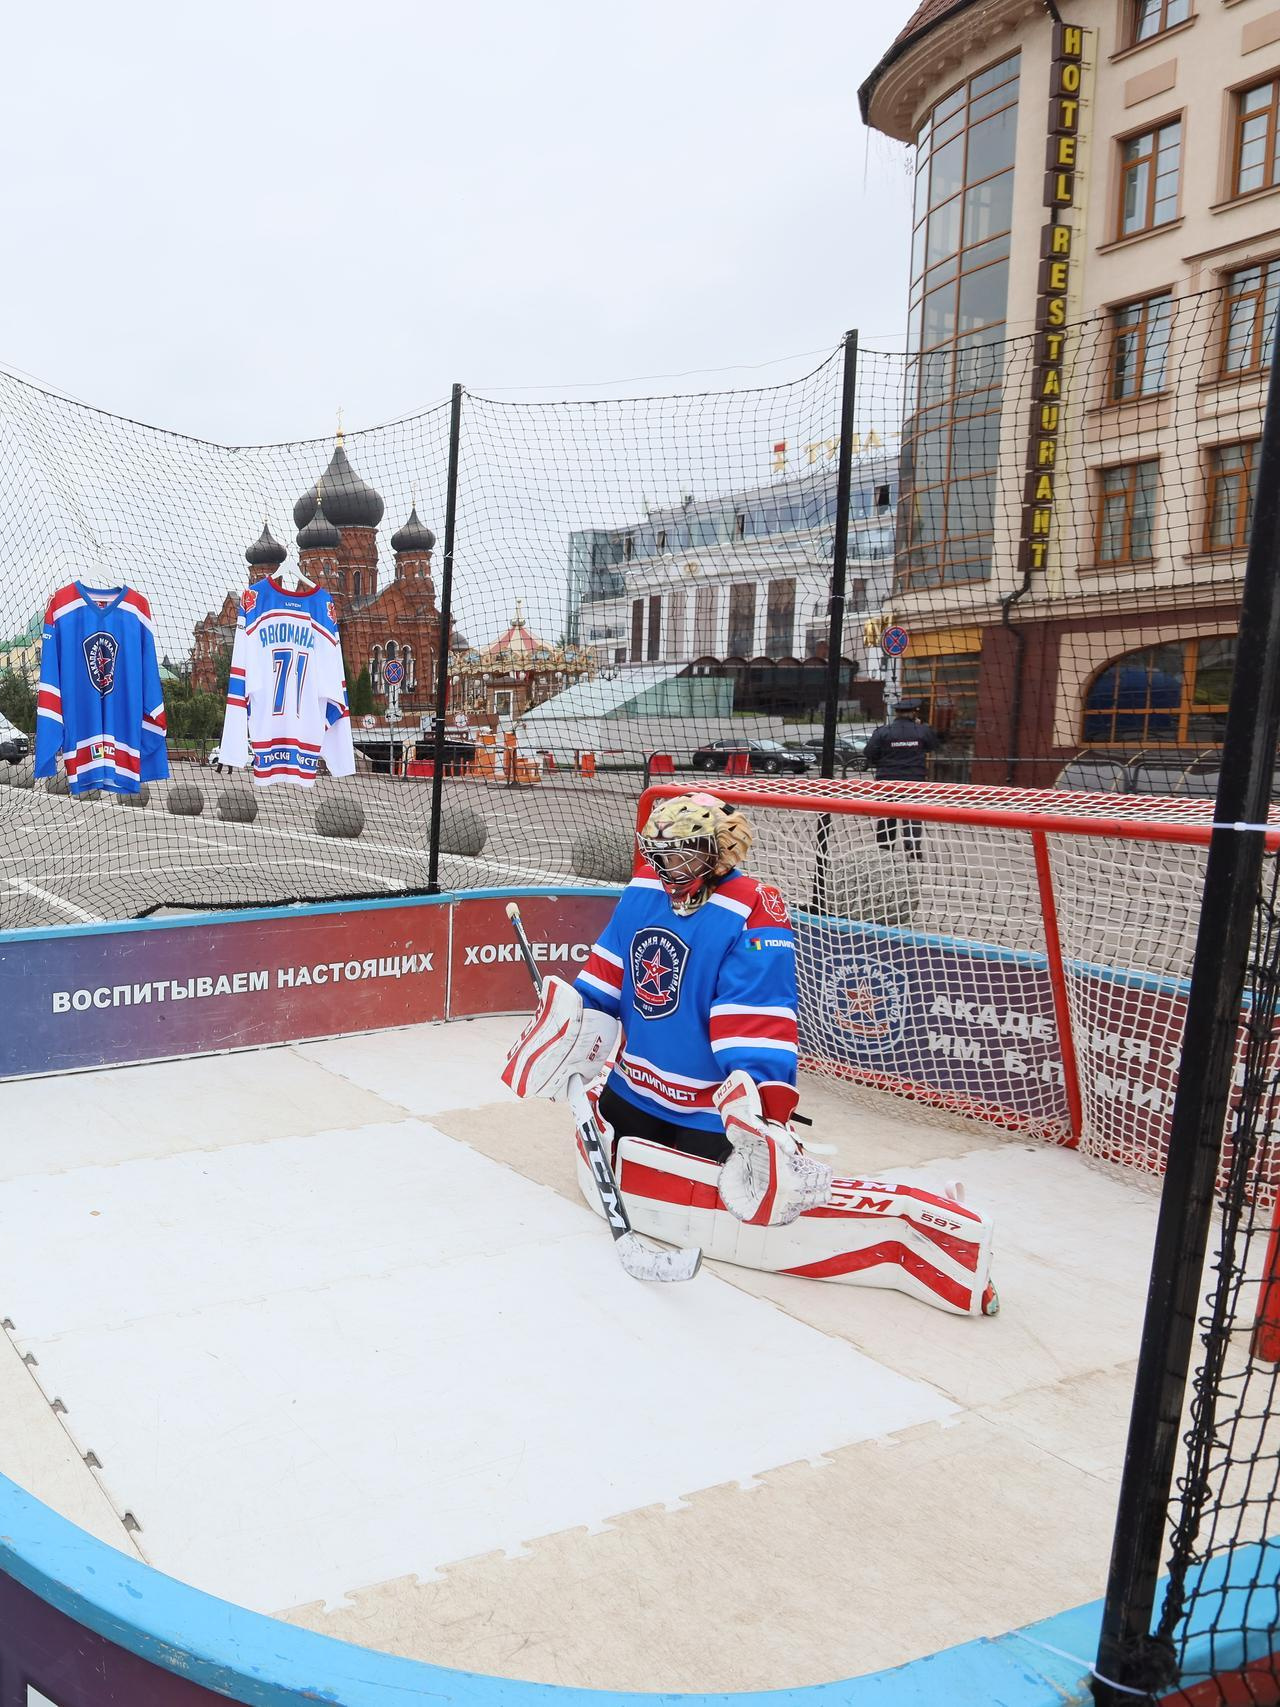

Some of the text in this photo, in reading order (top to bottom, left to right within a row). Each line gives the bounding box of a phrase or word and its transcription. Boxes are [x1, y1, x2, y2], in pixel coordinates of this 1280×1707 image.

[1056, 26, 1081, 201] HOTEL
[1031, 226, 1070, 569] RESTAURANT
[52, 969, 269, 1014] ВОСПИТЫВАЕМ
[276, 953, 434, 989] НАСТОЯЩИХ
[580, 1117, 628, 1230] CCM
[920, 1212, 962, 1231] 597
